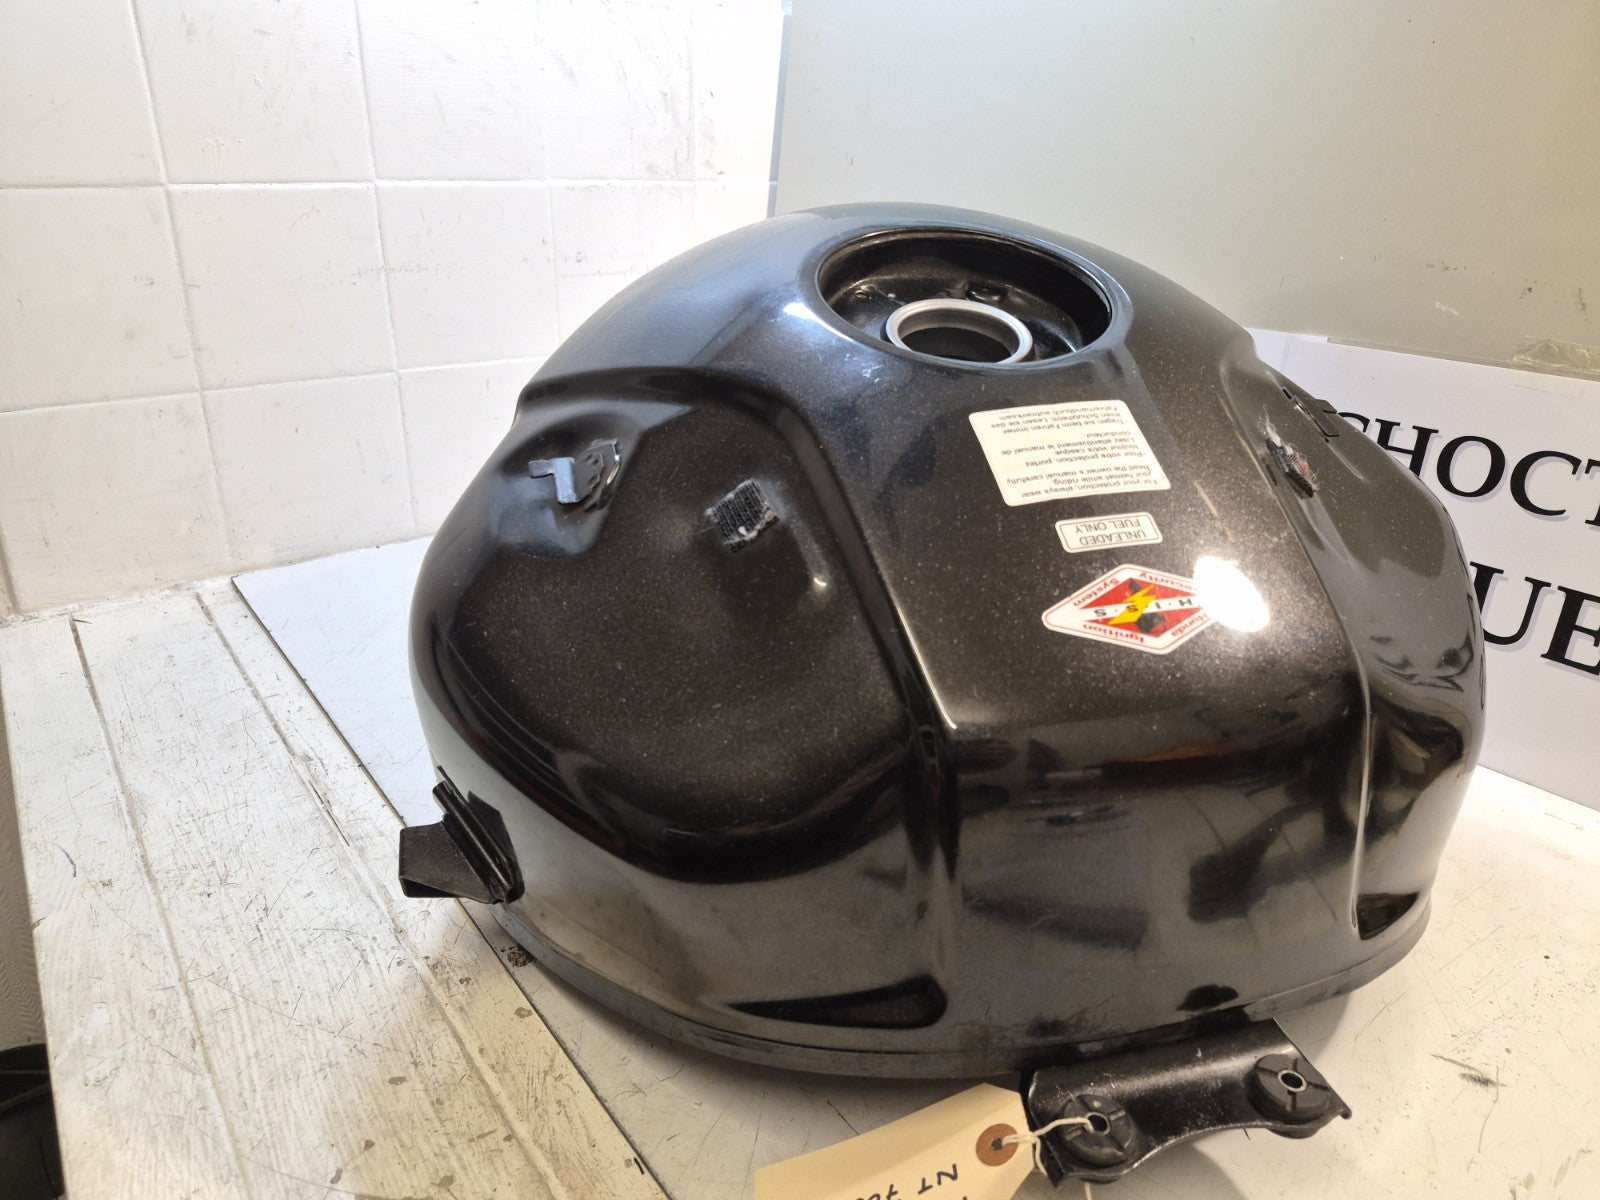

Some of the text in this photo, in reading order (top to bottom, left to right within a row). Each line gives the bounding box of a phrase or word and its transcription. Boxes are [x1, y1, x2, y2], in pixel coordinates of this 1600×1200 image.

[1014, 446, 1045, 455] manuel
[1025, 458, 1053, 467] portez
[1337, 412, 1600, 527] HOC
[1046, 471, 1078, 480] manual
[1081, 475, 1103, 483] while
[1105, 473, 1133, 481] helmet
[1123, 478, 1141, 486] your
[1021, 490, 1042, 498] wear
[1043, 486, 1073, 495] always
[1075, 518, 1142, 534] FUEL ONLY
[1079, 530, 1146, 546] UNLEADED
[1073, 578, 1119, 607] System
[1083, 624, 1144, 644] Ignition
[918, 1164, 958, 1196] NT
